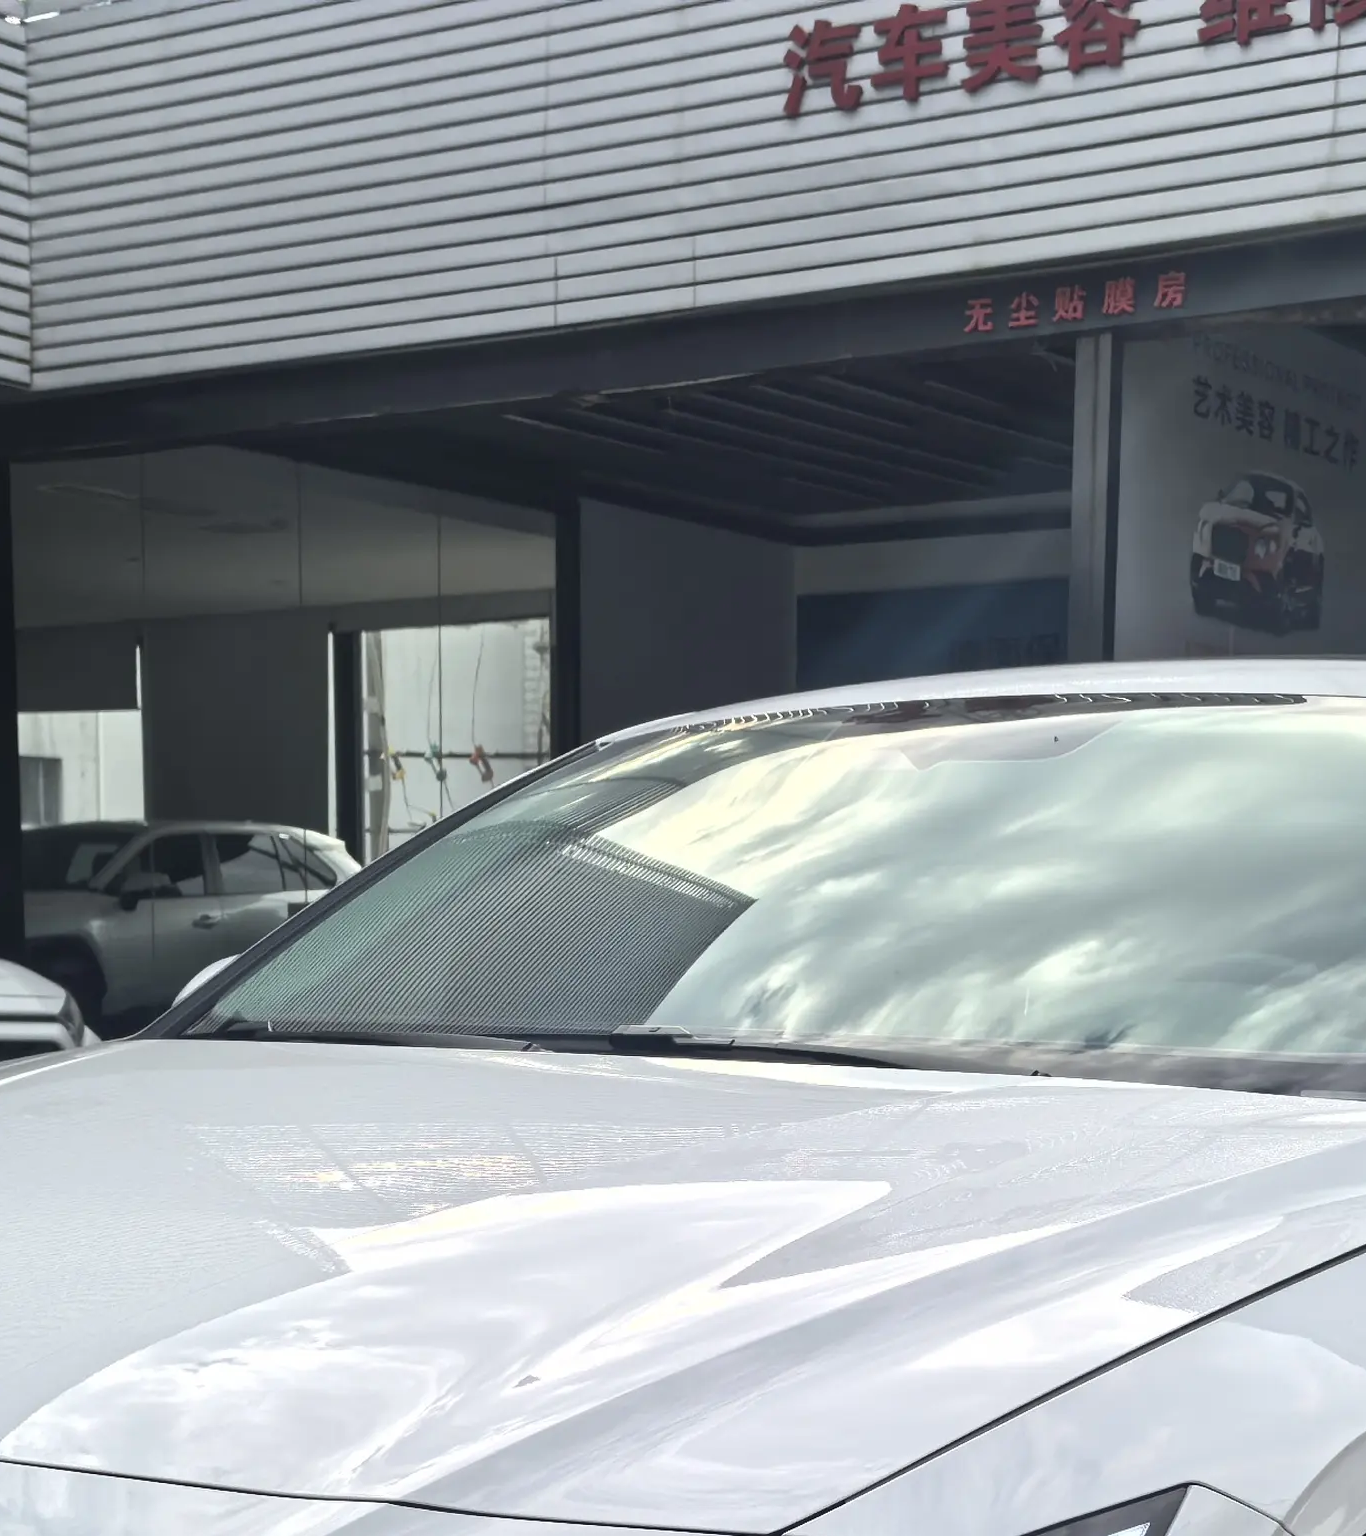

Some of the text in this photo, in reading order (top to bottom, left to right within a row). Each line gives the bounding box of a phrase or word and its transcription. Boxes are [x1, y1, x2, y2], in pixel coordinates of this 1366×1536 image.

[782, 0, 1139, 117] 汽车美容
[963, 271, 1187, 333] 无尘贴膜房
[1192, 374, 1275, 443] 艺术美容
